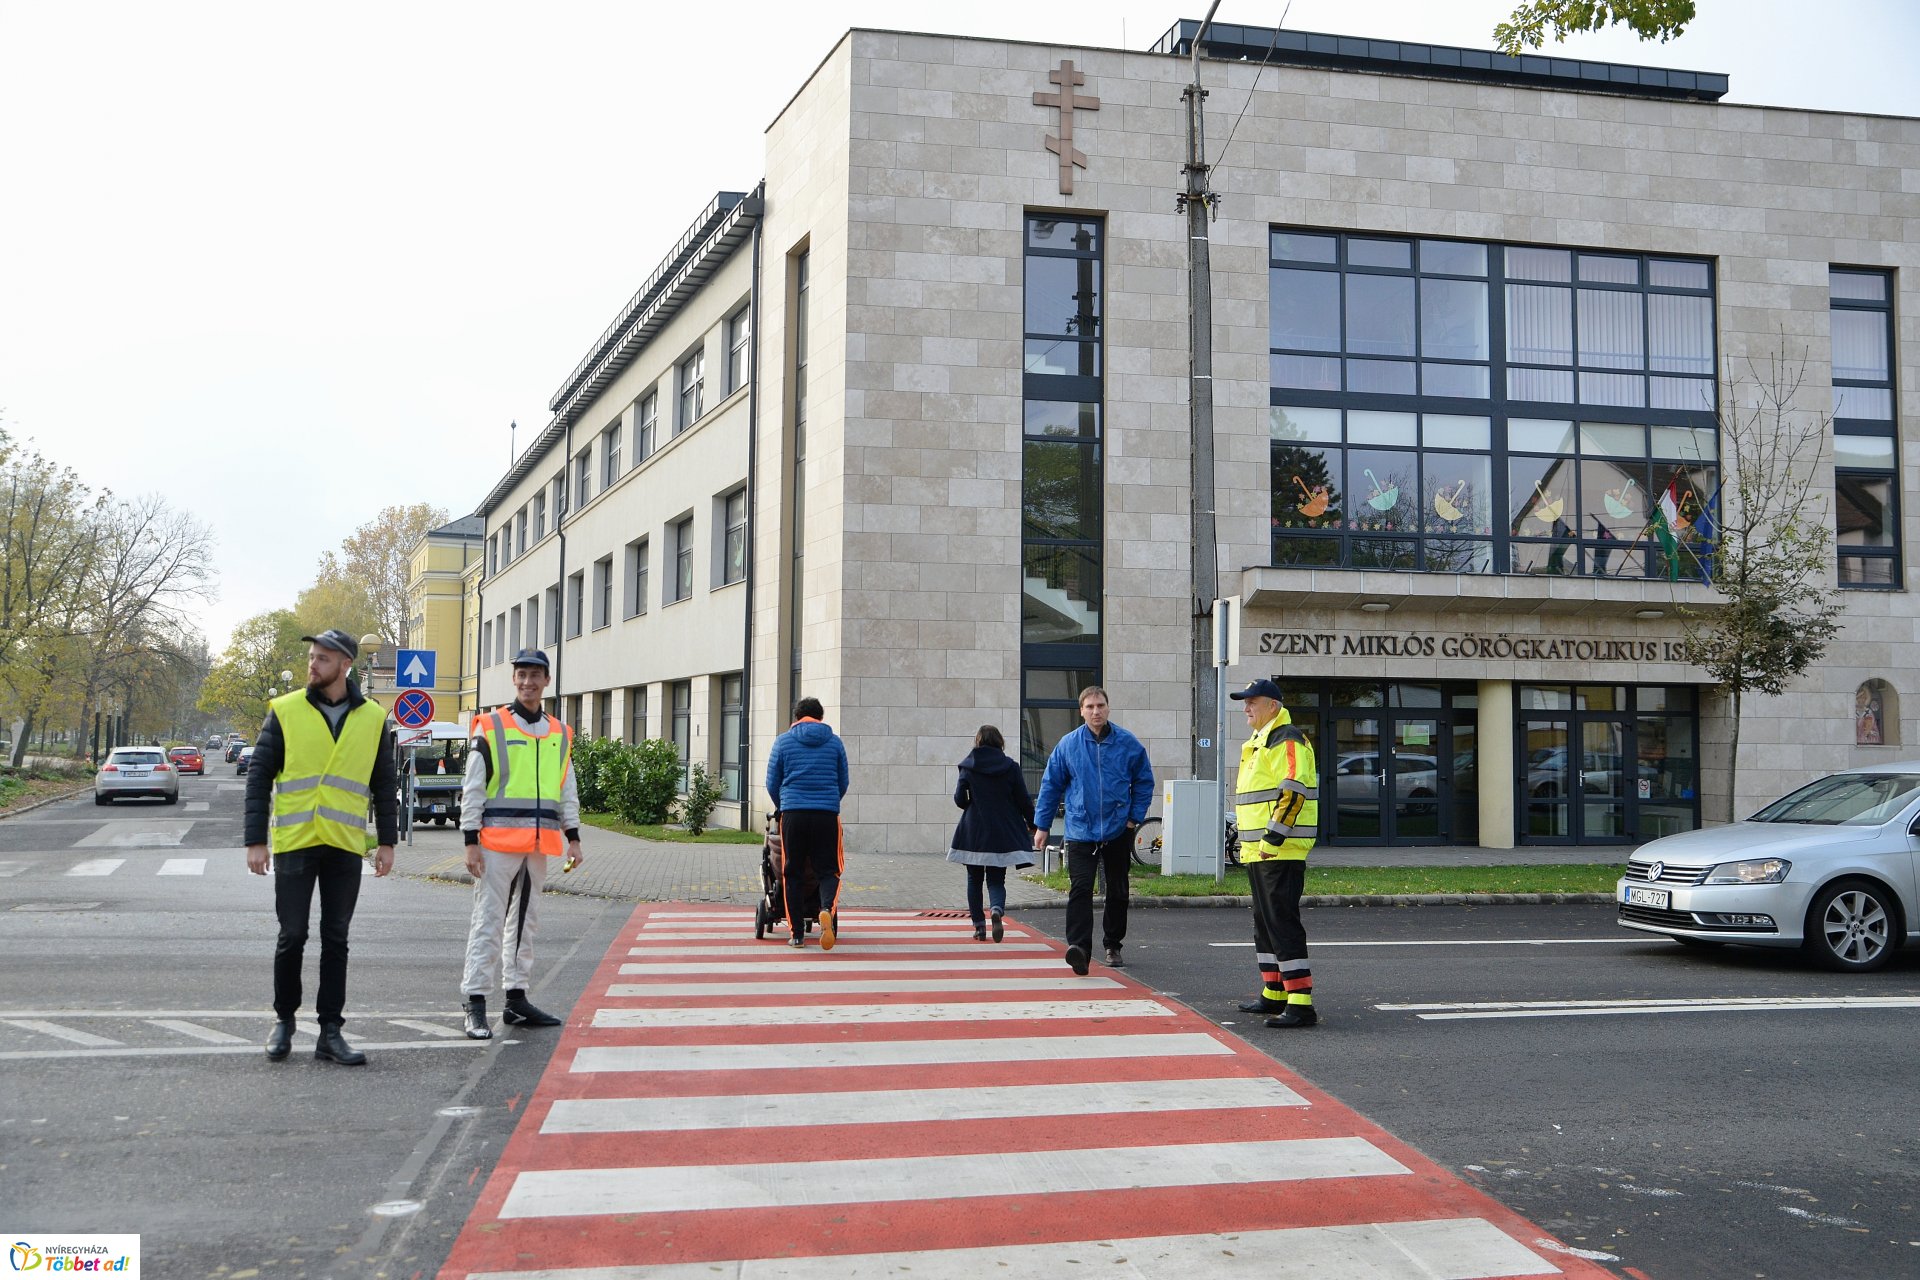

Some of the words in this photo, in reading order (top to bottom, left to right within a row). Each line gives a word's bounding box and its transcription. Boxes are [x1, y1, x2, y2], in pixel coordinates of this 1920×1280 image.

[1260, 633, 1336, 655] SZENT
[1342, 631, 1435, 657] MIKLÓS
[1442, 633, 1657, 660] GÖRÖGKATOLIKUS
[1630, 890, 1666, 905] MGL-727
